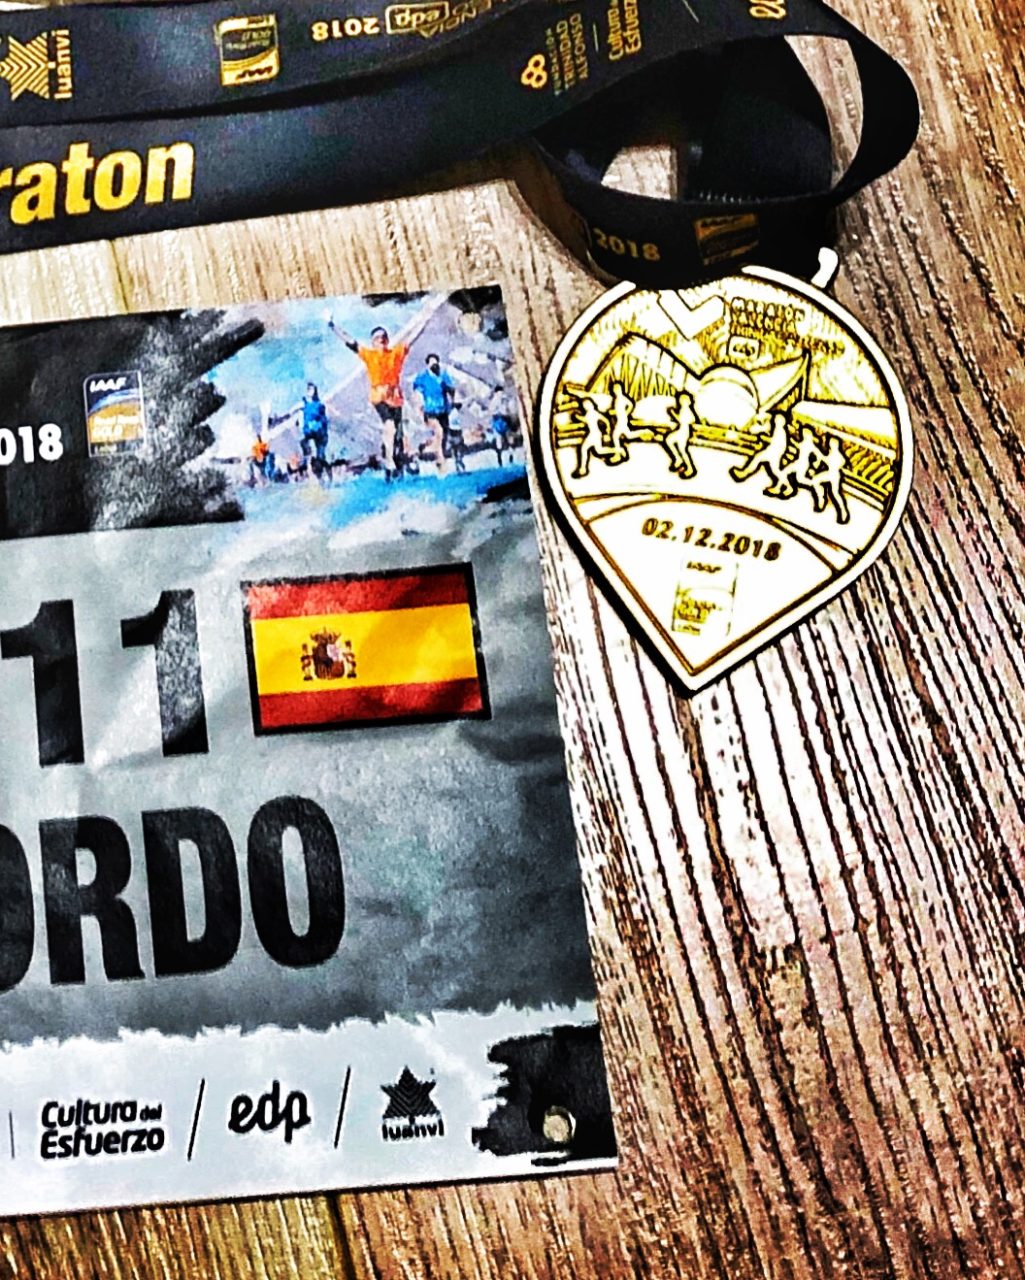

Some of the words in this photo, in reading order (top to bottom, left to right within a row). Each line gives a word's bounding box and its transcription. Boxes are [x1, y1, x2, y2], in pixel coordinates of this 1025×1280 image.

[312, 17, 380, 42] 2018
[570, 12, 589, 80] ALFONSO
[51, 29, 74, 101] luanvi
[556, 20, 576, 90] TRINIDAD
[592, 226, 662, 262] 2018
[640, 516, 783, 562] 02.12.2018
[41, 1098, 137, 1128] Cultura
[138, 1103, 163, 1122] del
[228, 1080, 312, 1145] edp
[381, 1116, 445, 1142] luanvi
[40, 1125, 166, 1161] Esfuerzo
